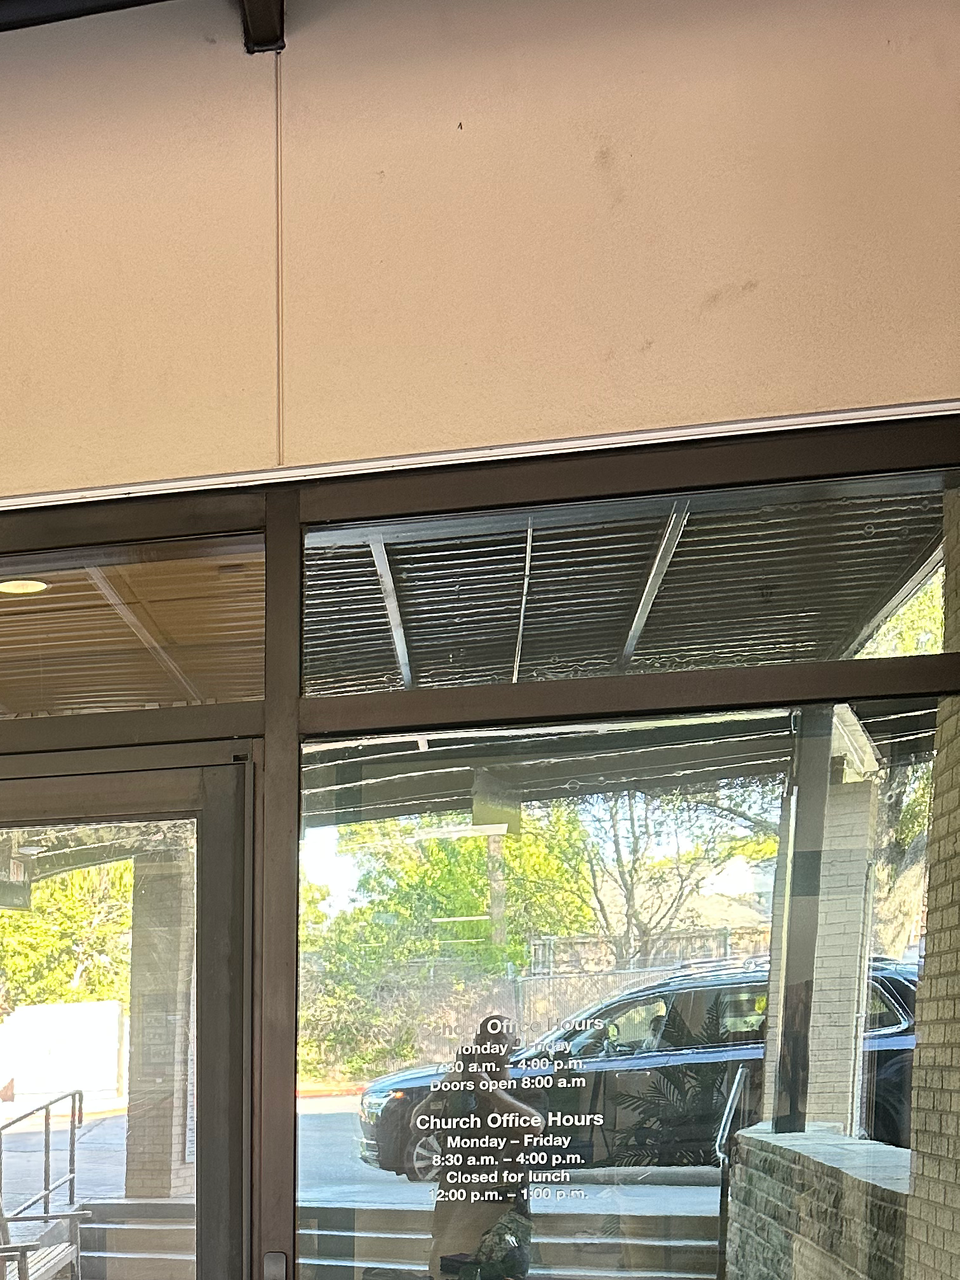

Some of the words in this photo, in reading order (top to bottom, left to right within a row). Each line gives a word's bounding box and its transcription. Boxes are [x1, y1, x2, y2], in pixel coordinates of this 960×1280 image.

[488, 1019, 540, 1034] Office
[548, 1018, 604, 1032] Hours
[468, 1063, 500, 1072] a.m.
[518, 1058, 549, 1070] 4:00
[554, 1059, 586, 1072] p.m.
[431, 1080, 474, 1091] Doors
[480, 1079, 516, 1092] open
[522, 1076, 553, 1088] 8:00
[558, 1077, 586, 1088] a.m
[416, 1114, 481, 1129] Church
[487, 1112, 541, 1128] Office
[548, 1112, 604, 1127] Hours
[447, 1136, 506, 1149] Monday
[524, 1134, 571, 1148] Friday
[432, 1154, 462, 1166] 8:30
[467, 1156, 498, 1165] a.m.
[516, 1152, 547, 1164] 4:00
[552, 1153, 585, 1166] p.m.
[446, 1171, 498, 1183] Closed
[502, 1171, 524, 1182] for
[529, 1170, 570, 1182] lunch
[429, 1189, 466, 1201] 12:00
[470, 1190, 502, 1203] p.m.
[521, 1188, 551, 1200] 1:00
[556, 1188, 588, 1201] p.m.
